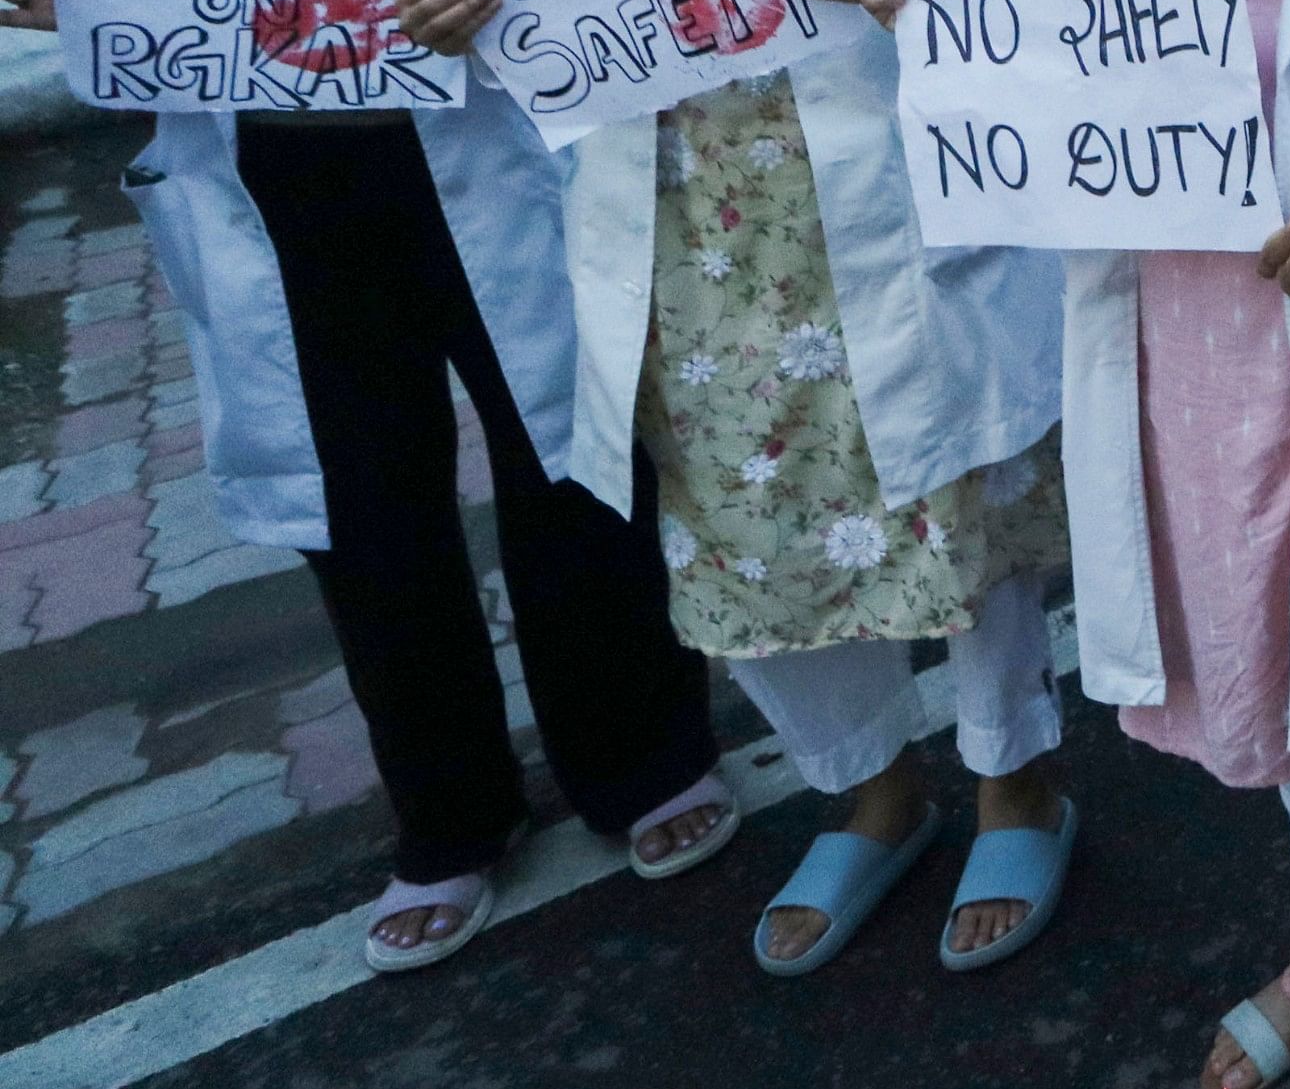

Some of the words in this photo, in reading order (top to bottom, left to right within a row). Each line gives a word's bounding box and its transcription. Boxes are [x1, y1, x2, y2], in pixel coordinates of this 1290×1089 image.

[93, 23, 454, 108] RGKAR
[927, 120, 1030, 198] NO
[1068, 116, 1259, 207] DUTY!
